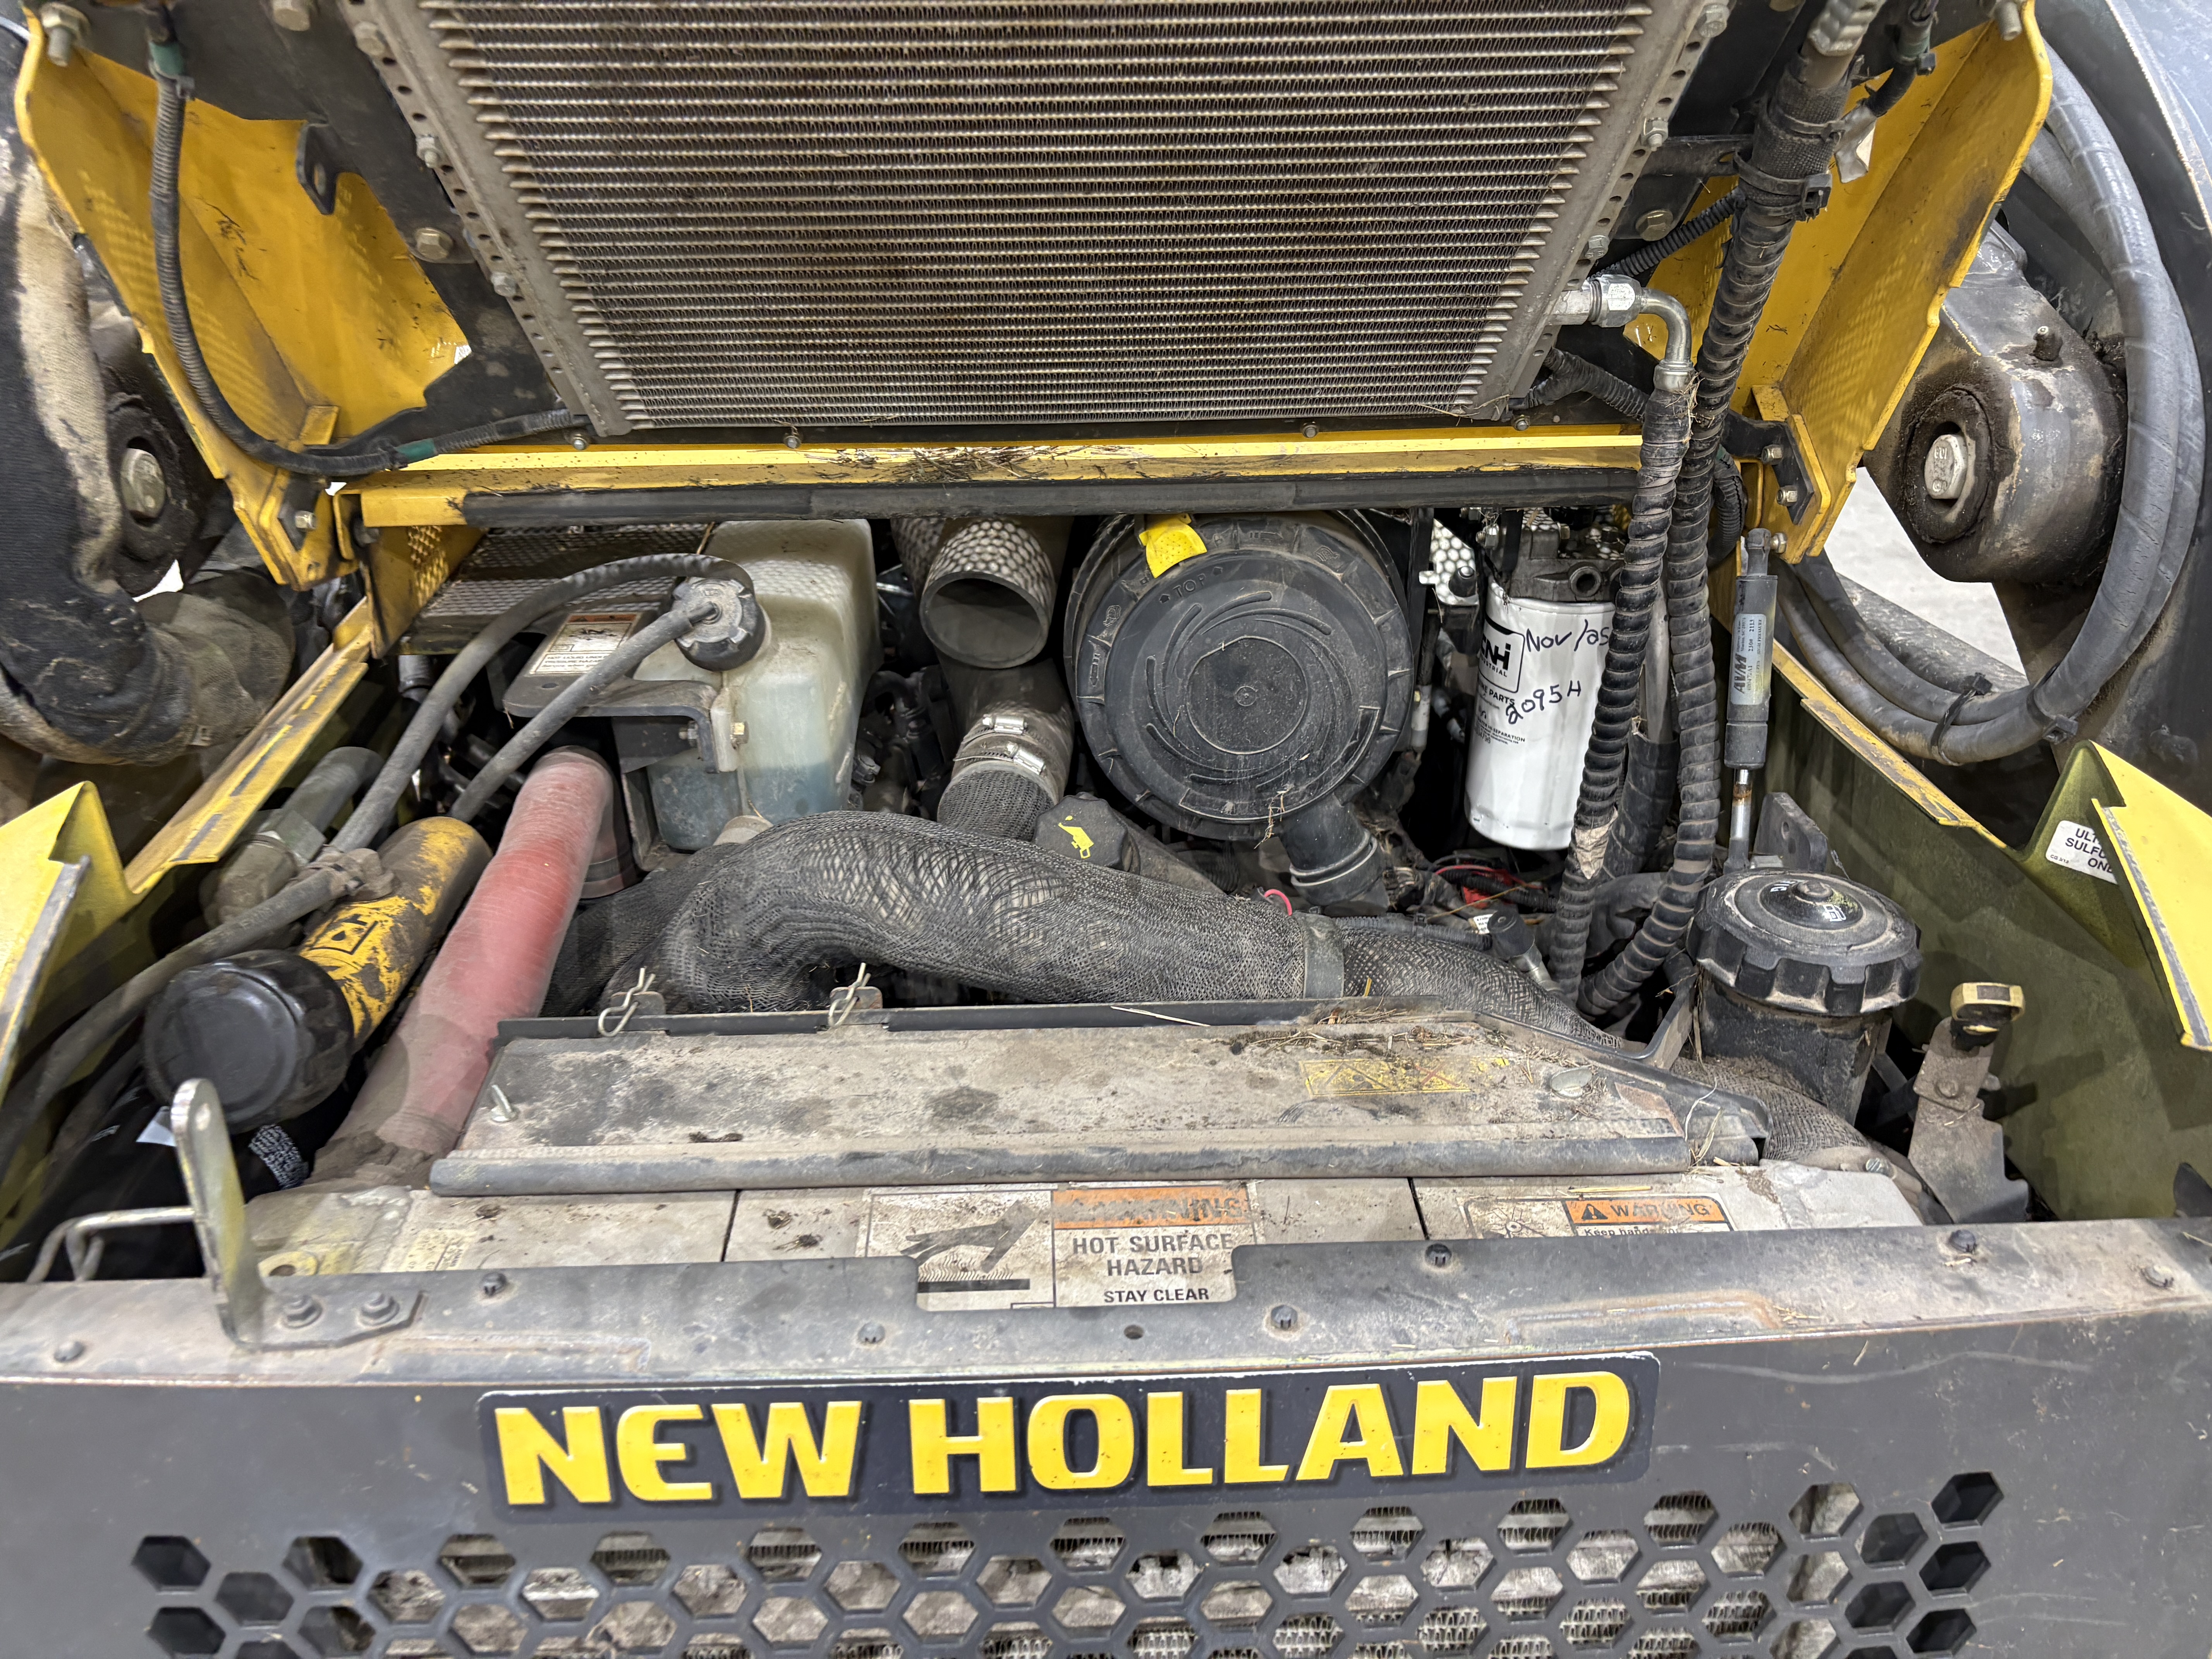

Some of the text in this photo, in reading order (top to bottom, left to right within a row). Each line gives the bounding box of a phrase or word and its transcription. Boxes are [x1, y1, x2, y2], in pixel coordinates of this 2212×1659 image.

[1173, 573, 1206, 598] TOP
[1734, 653, 1747, 694] AVM
[1489, 689, 1515, 706] PARTS
[2075, 828, 2099, 843] ULT
[2065, 837, 2106, 859] SULFU
[2088, 858, 2112, 874] ONL
[1073, 1233, 1232, 1254] HOT SURFACE
[1107, 1257, 1203, 1277] HAZARD
[1104, 1288, 1209, 1303] STAY CLEAR
[493, 1371, 1630, 1504] NEW HOLLAND
